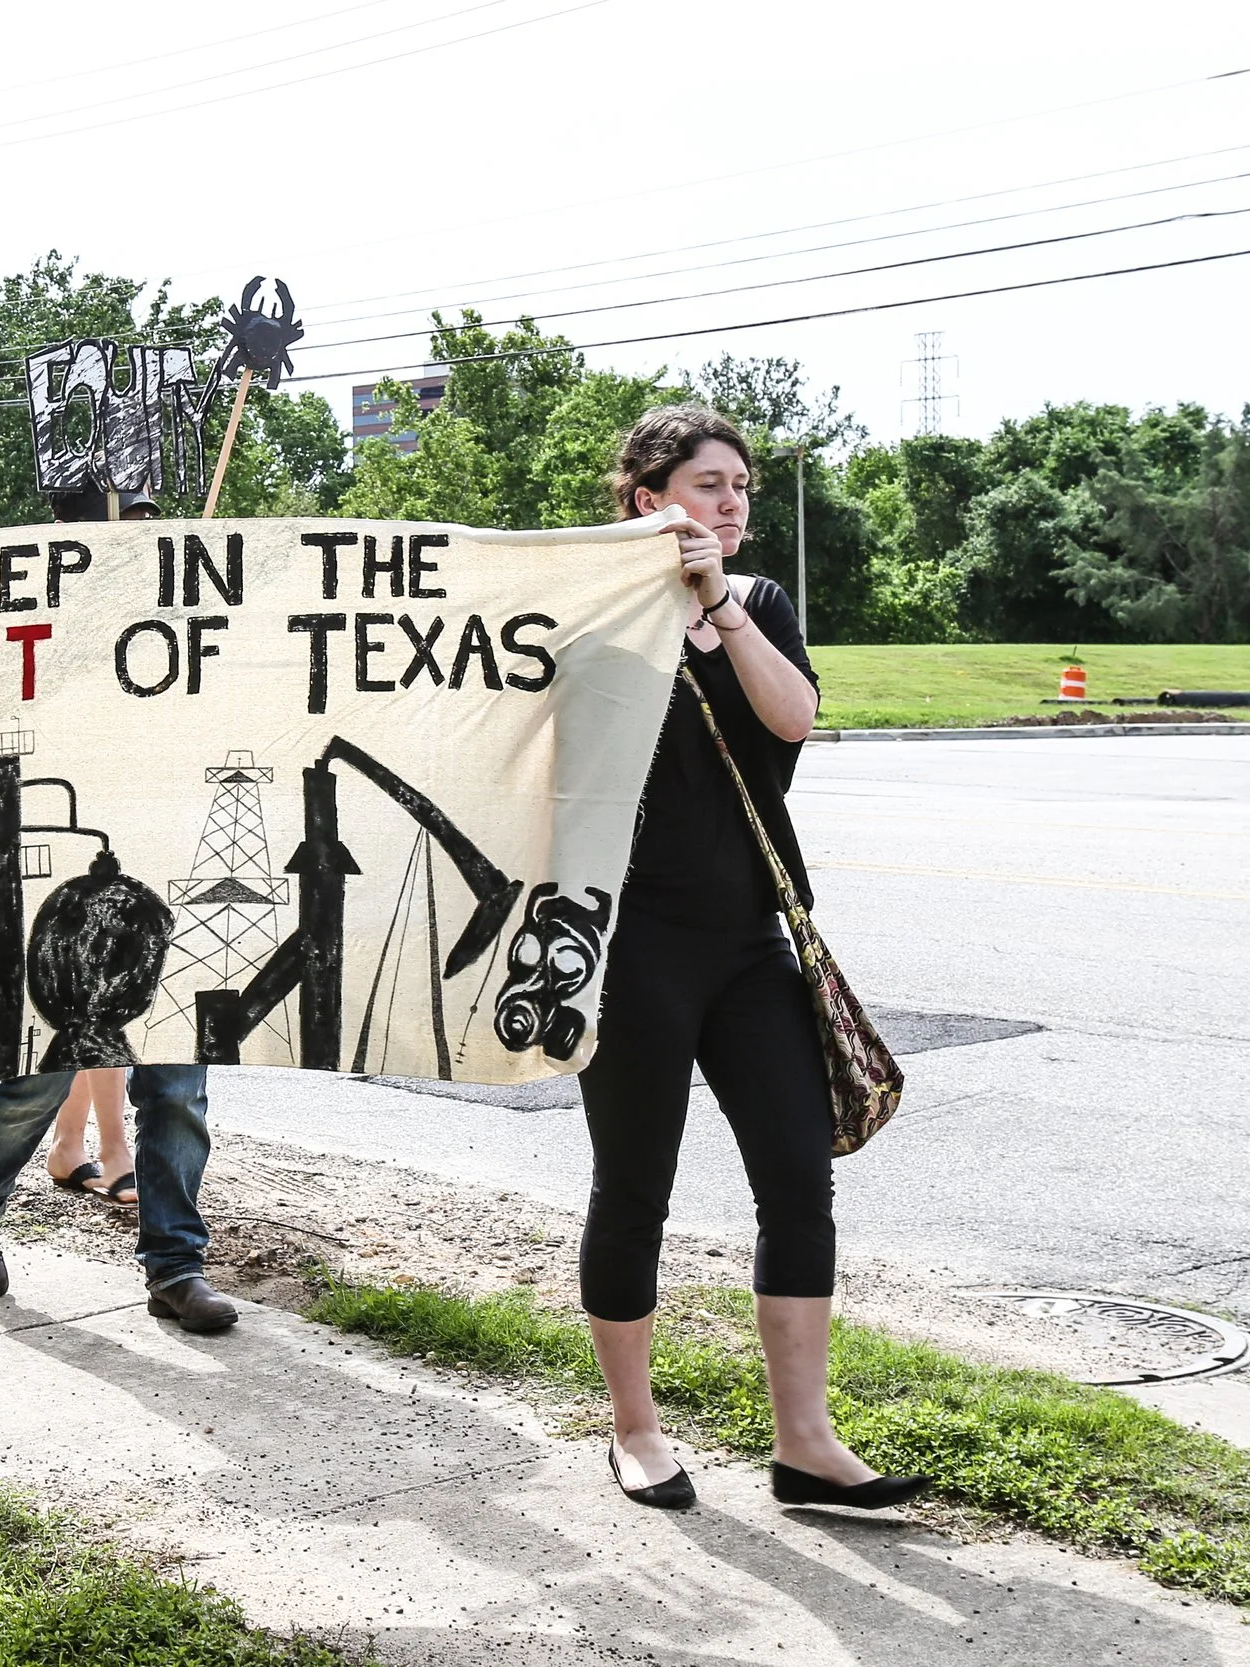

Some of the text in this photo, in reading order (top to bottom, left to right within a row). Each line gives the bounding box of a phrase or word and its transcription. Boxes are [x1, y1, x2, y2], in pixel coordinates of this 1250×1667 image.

[157, 532, 244, 608] IN
[300, 531, 449, 600] THE
[114, 615, 230, 697] OF
[287, 612, 559, 715] TEXAS
